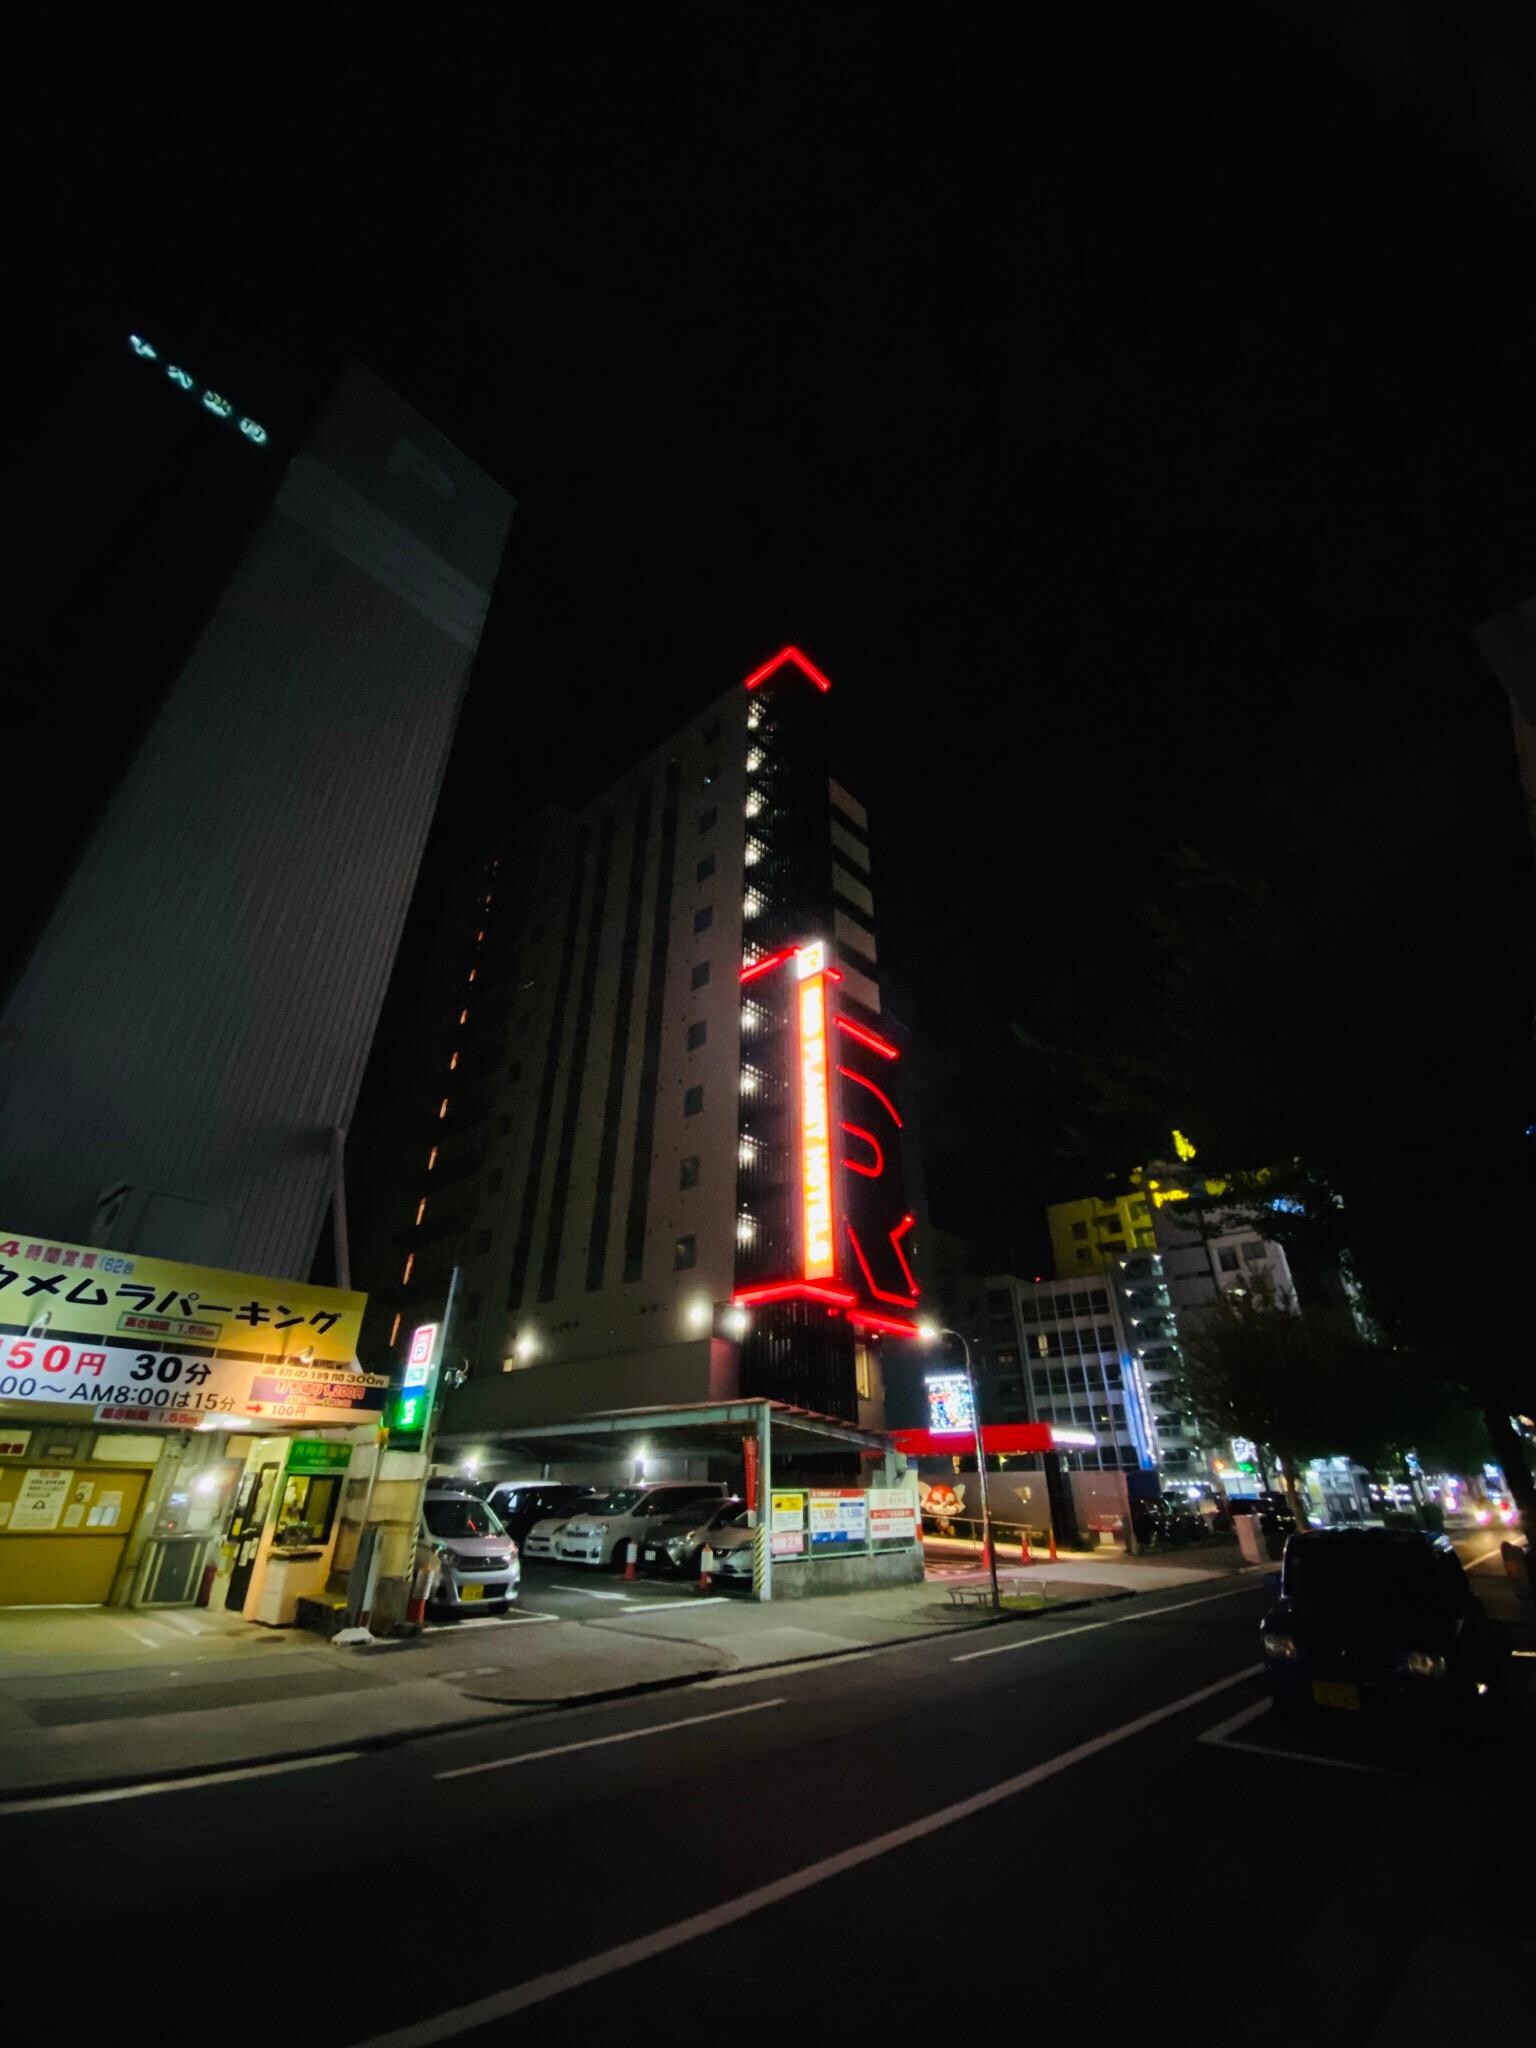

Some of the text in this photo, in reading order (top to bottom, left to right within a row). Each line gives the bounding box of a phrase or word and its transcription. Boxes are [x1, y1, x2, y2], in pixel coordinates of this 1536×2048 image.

[804, 1041, 827, 1139] PLANET
[805, 1145, 831, 1264] HOTELS
[0, 1338, 212, 1386] 50円 30分
